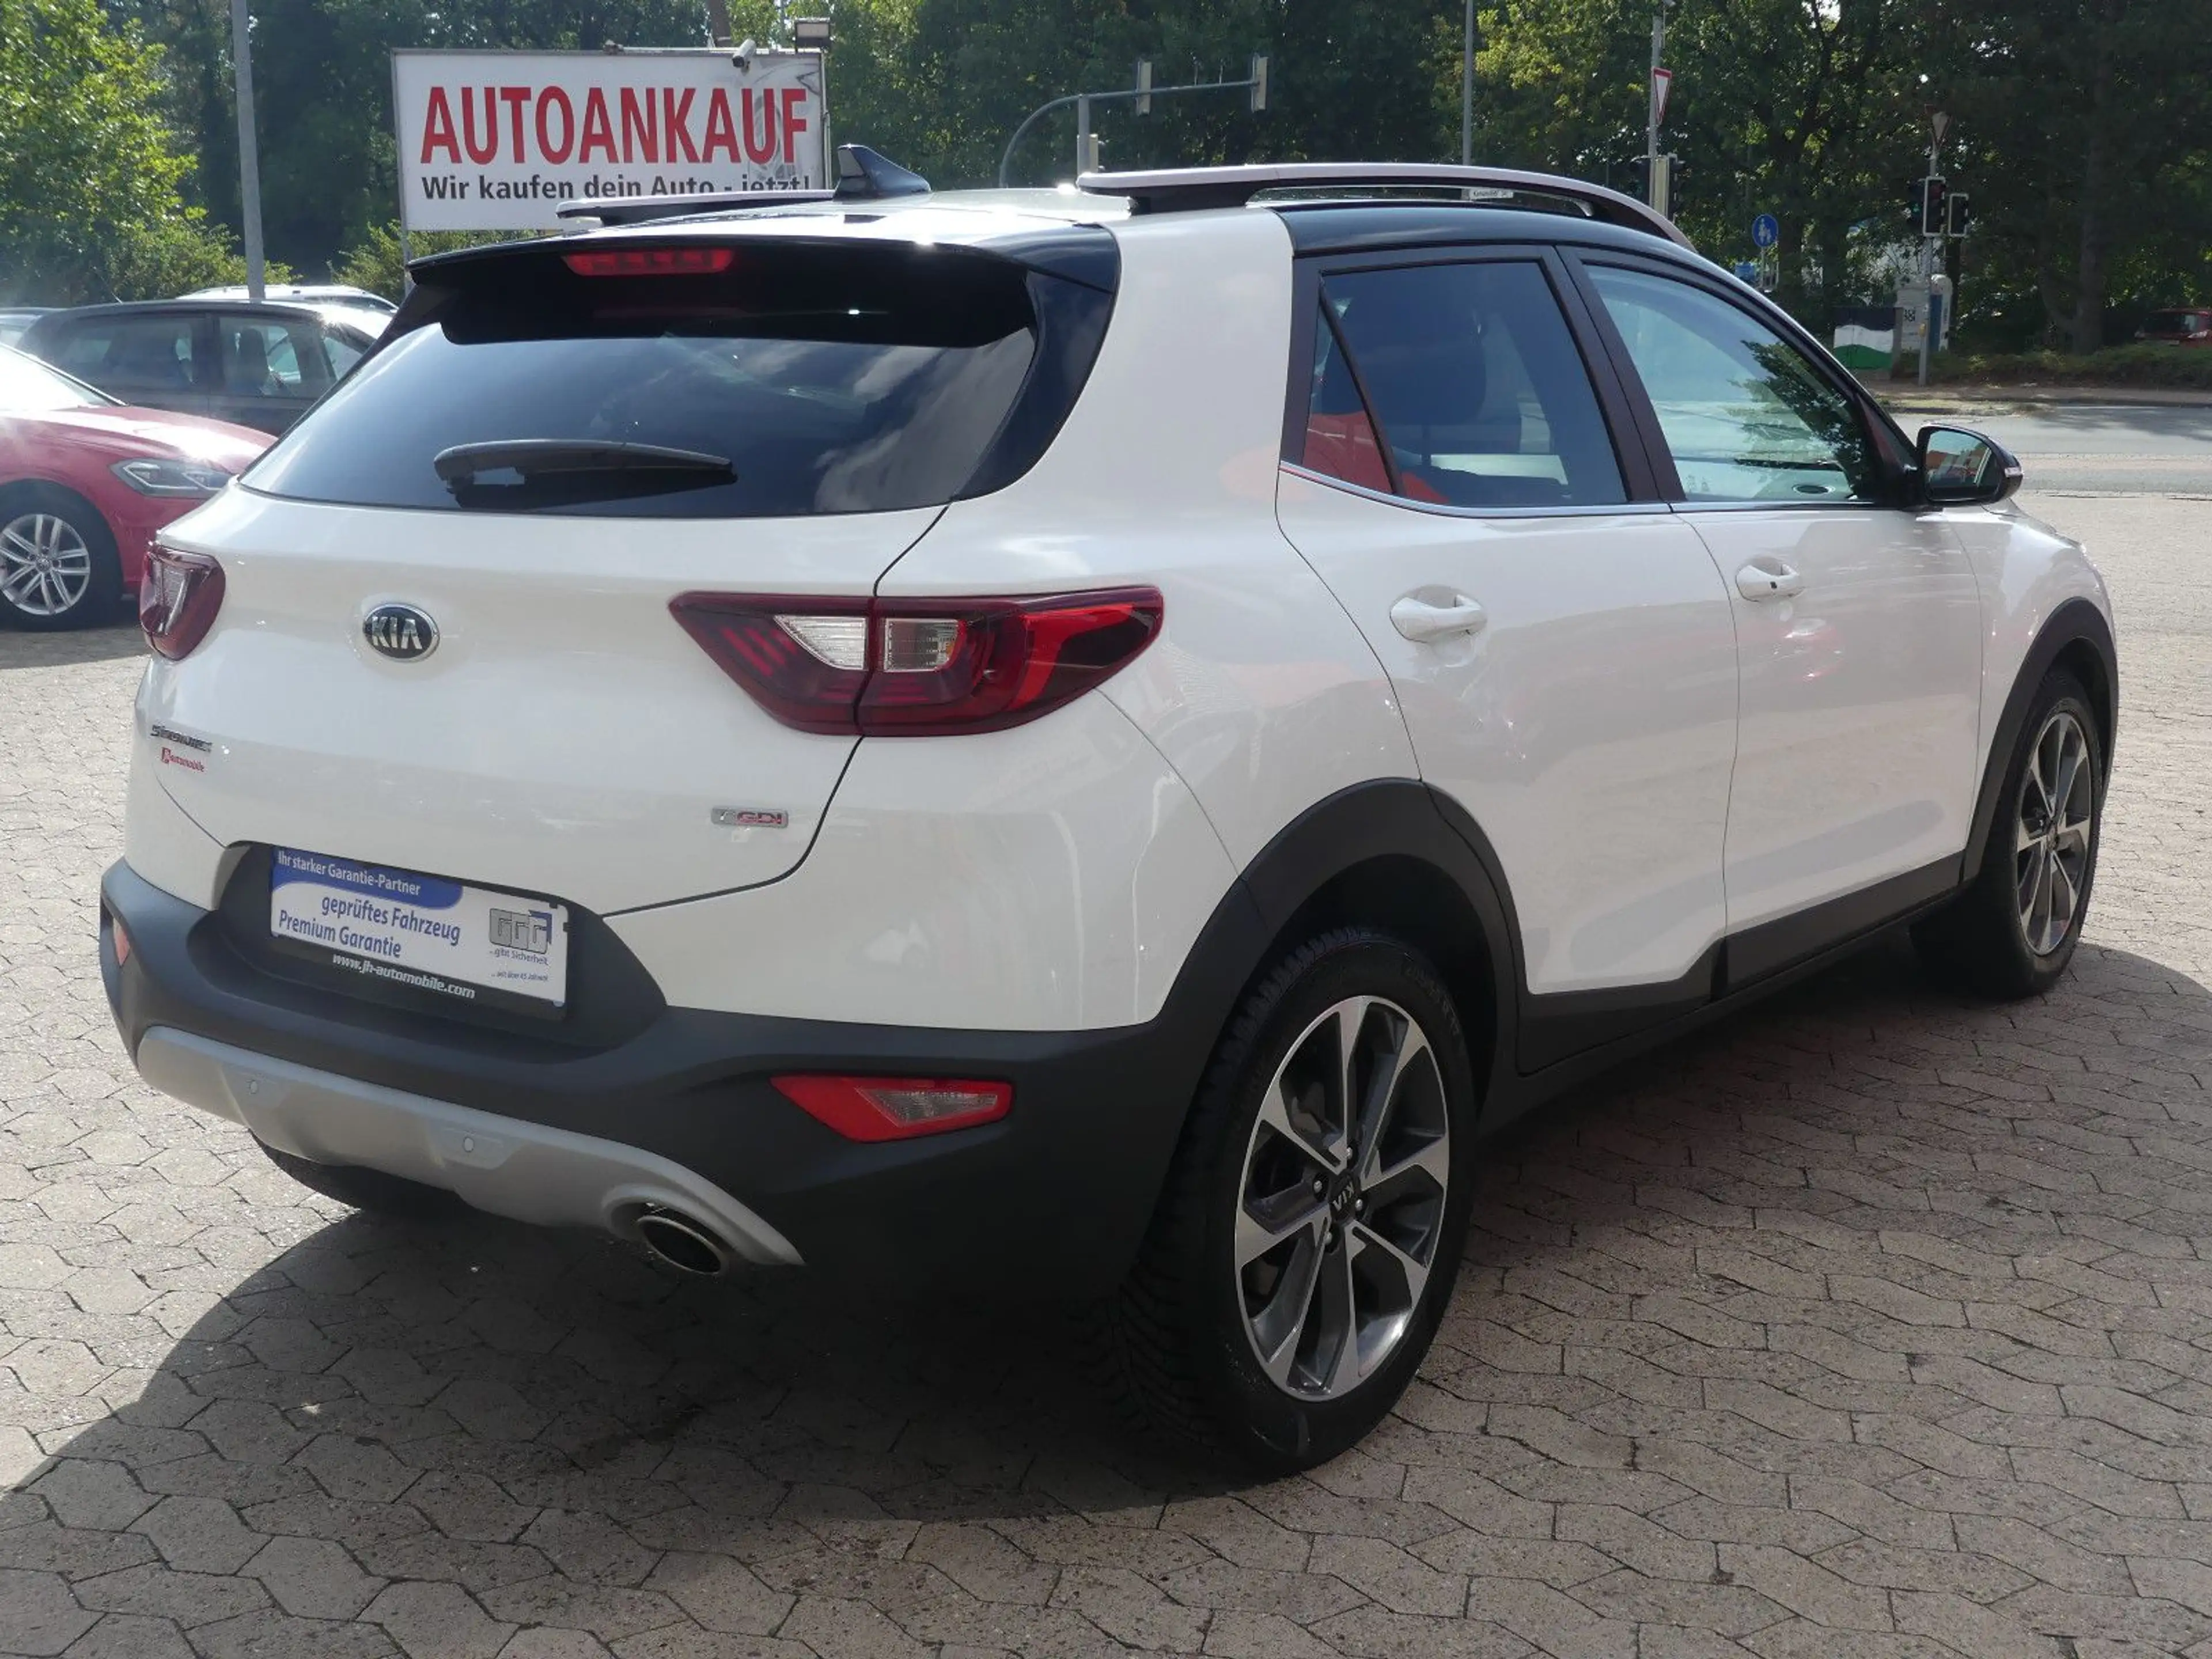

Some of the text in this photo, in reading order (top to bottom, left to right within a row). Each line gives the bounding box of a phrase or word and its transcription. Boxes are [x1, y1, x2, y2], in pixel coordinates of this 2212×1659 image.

[421, 85, 808, 165] AUTOANKAUF
[422, 175, 469, 199] Wir
[479, 174, 574, 199] kaufen
[584, 174, 642, 199] dein
[651, 175, 714, 196] Auto
[742, 174, 809, 192] jetzt!
[372, 616, 423, 649] KIA
[278, 850, 422, 895] Ihr starker Garantie-Partner
[279, 910, 402, 959] Premium Garantie
[321, 896, 461, 946] geprüftes Fahrzeug
[332, 953, 476, 999] www.jh-automobile.com
[1332, 1181, 1355, 1211] KIA
